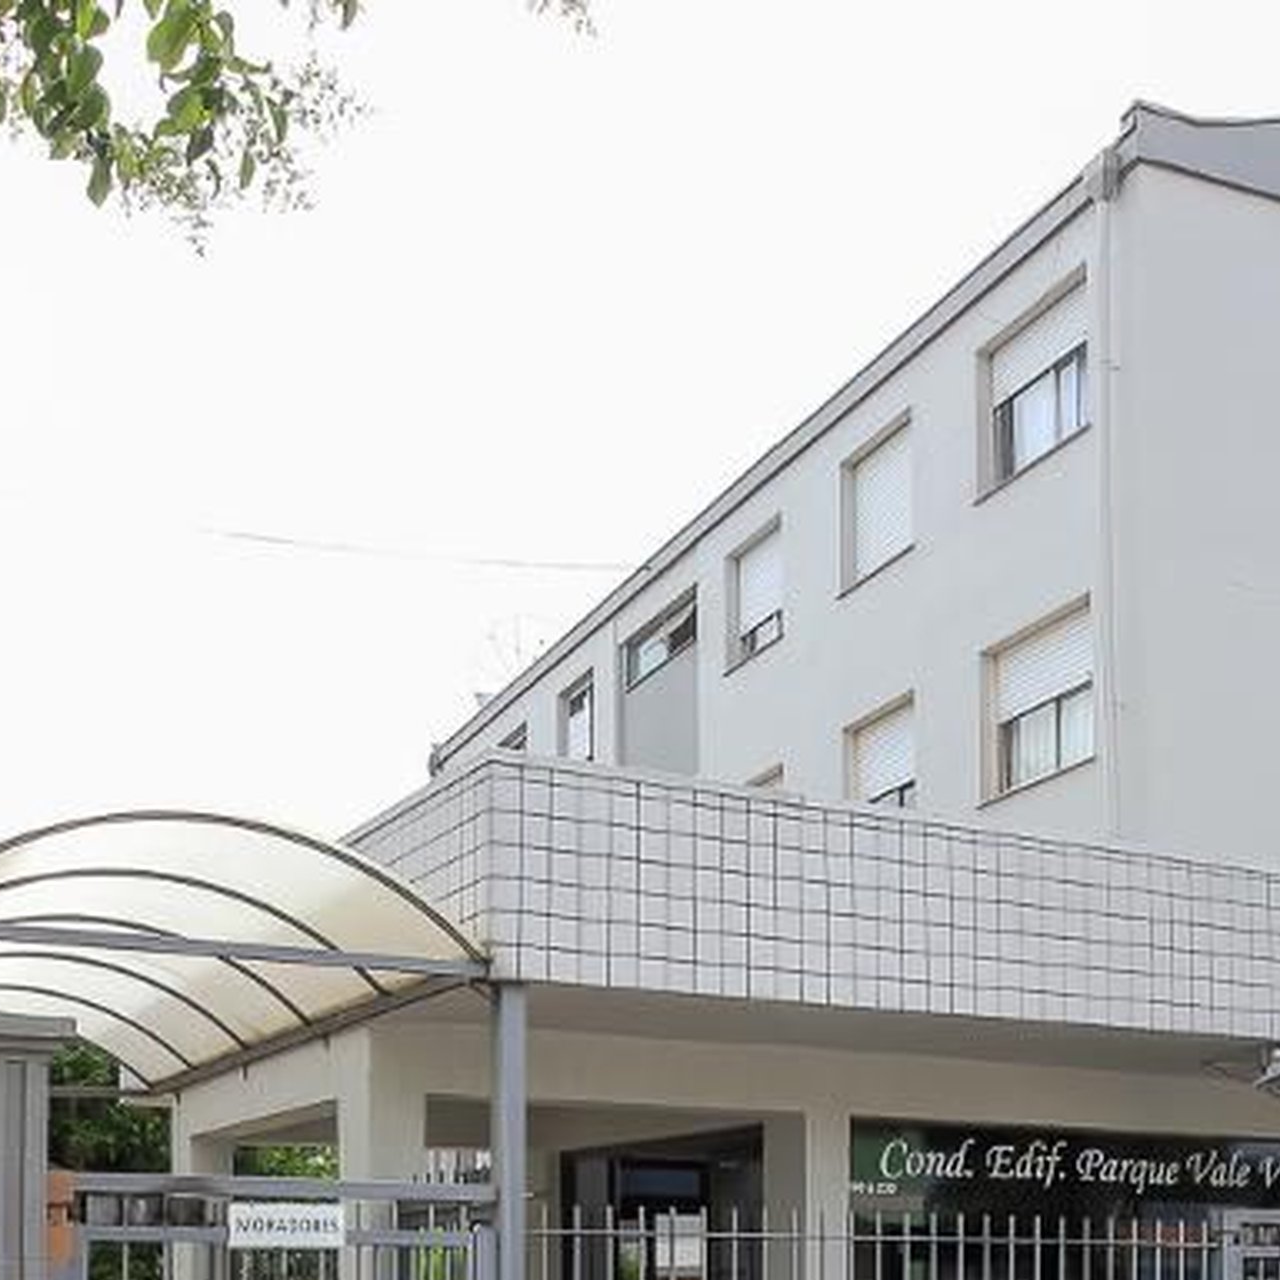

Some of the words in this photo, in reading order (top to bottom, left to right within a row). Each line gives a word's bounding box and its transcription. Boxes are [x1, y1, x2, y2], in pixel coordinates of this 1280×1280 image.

[879, 1138, 975, 1180] Cond.
[985, 1139, 1068, 1189] Edif.
[1075, 1148, 1179, 1195] Parque
[1185, 1150, 1251, 1187] Vale
